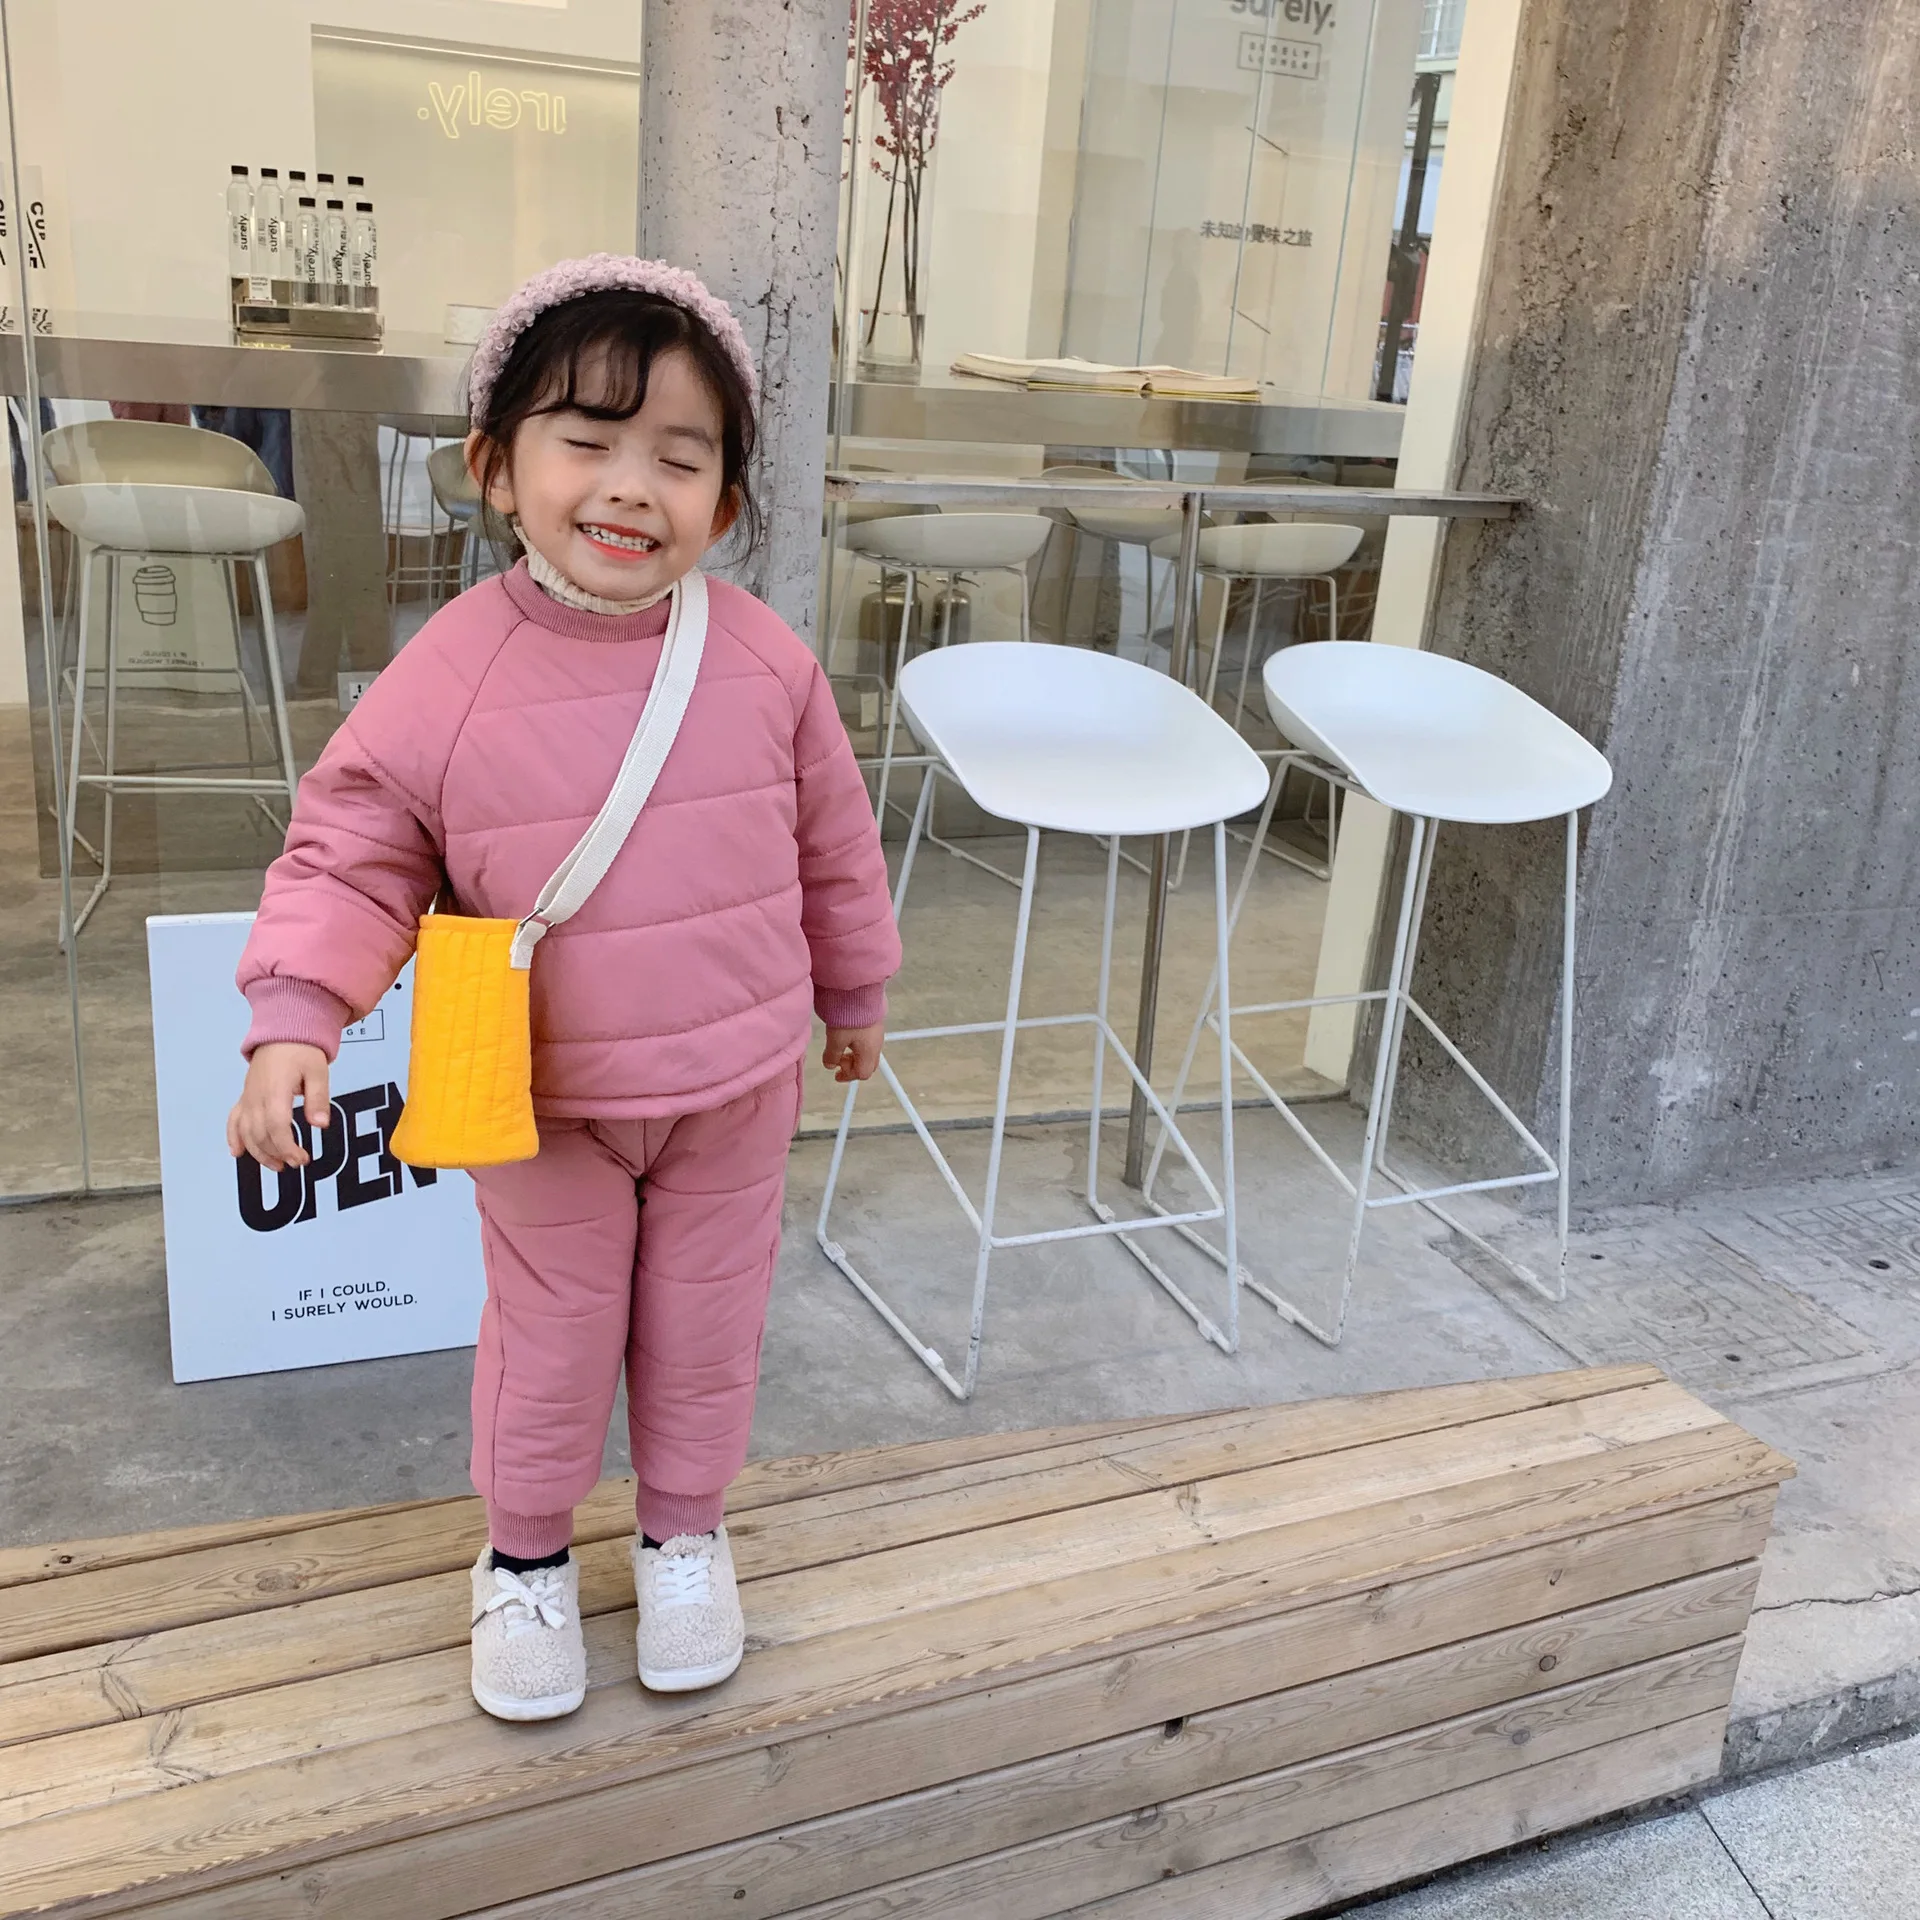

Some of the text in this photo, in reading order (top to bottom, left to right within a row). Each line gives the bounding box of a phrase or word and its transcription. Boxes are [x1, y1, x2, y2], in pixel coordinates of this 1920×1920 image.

[299, 1289, 312, 1301] IF
[320, 1288, 324, 1299] I
[271, 1294, 418, 1321] I SURELY WOULD.
